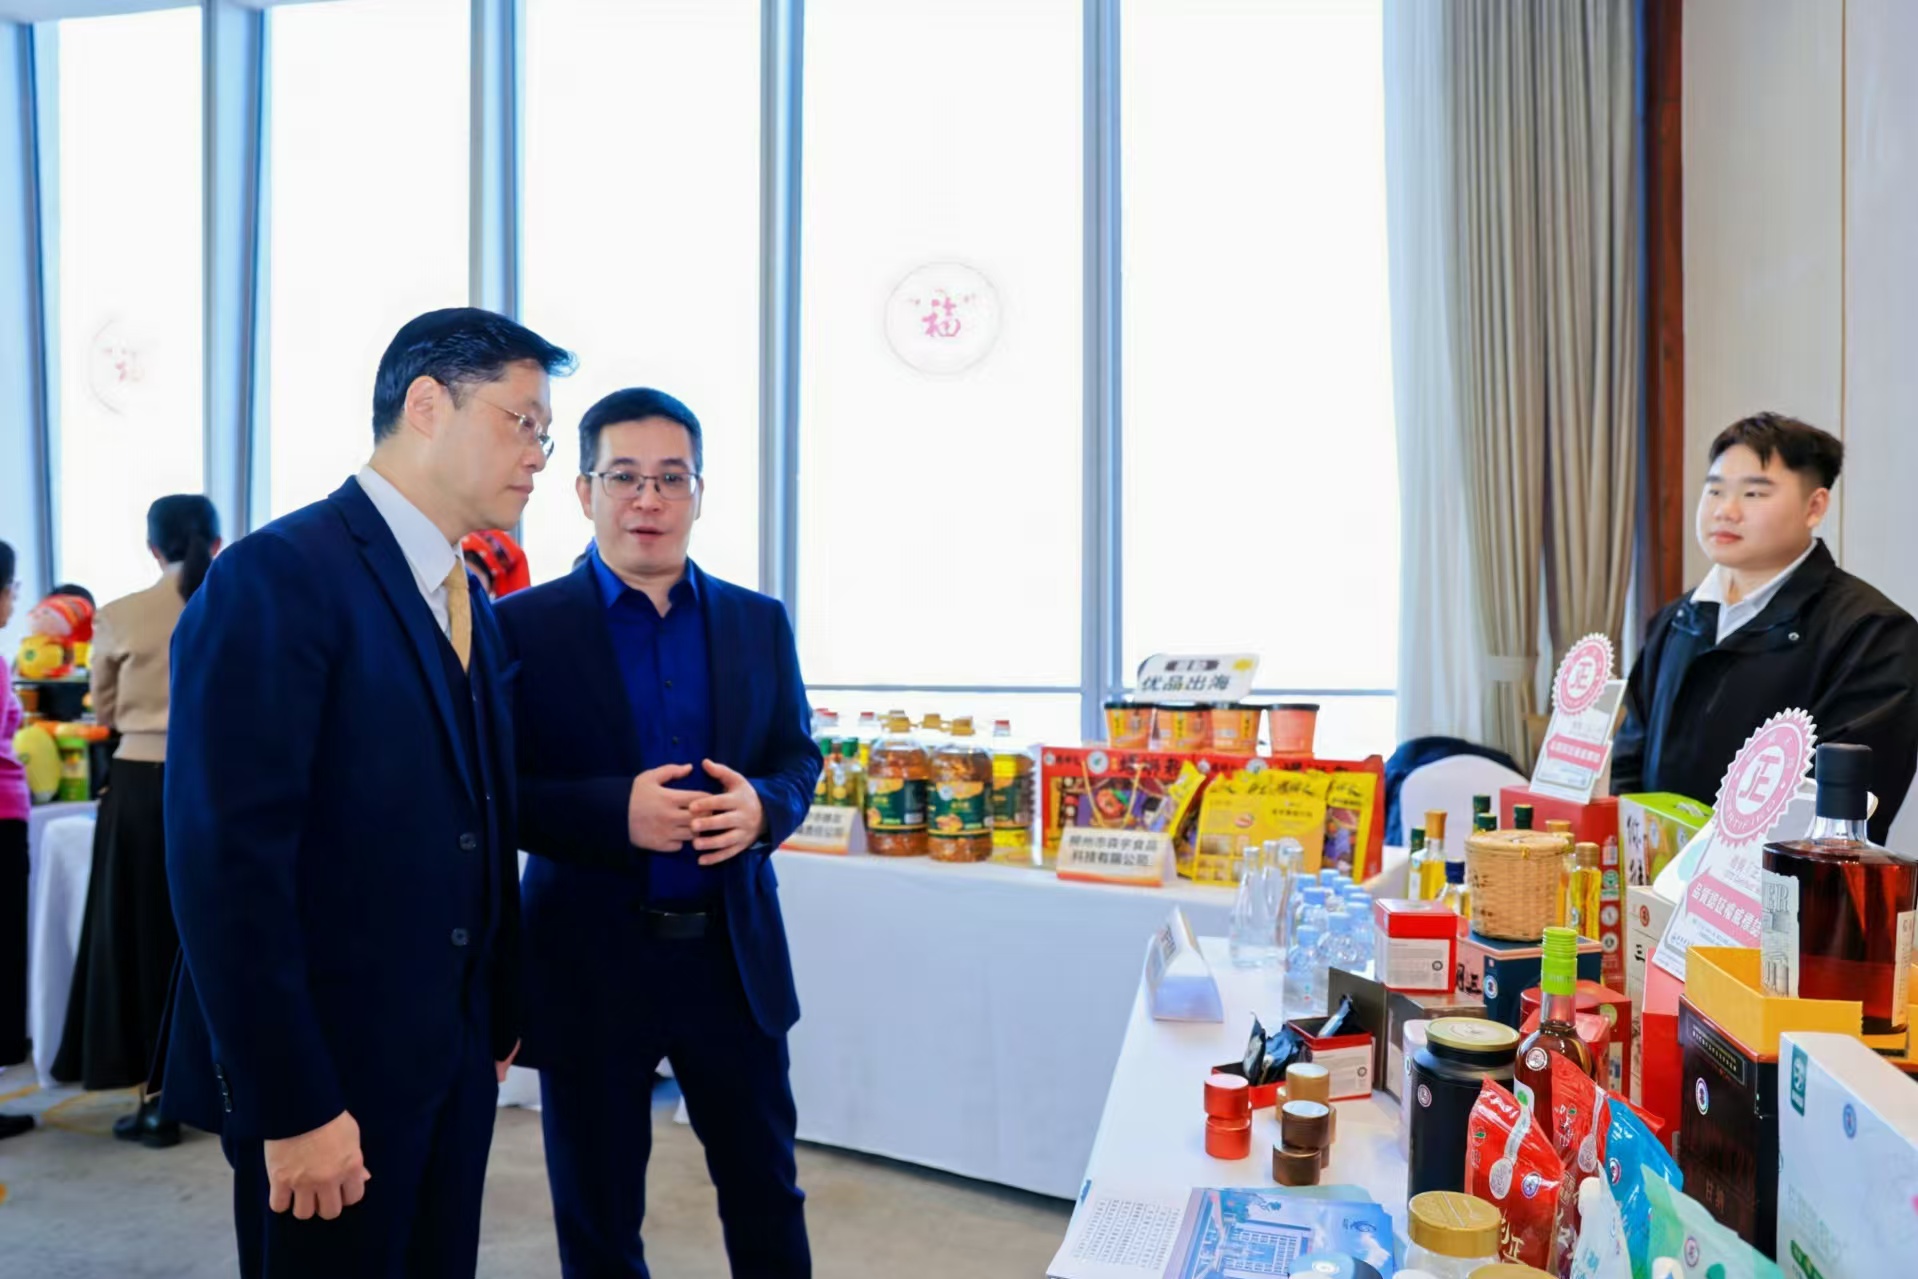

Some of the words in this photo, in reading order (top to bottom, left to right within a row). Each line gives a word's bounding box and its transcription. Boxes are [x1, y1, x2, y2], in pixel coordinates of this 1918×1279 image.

[1142, 675, 1231, 691] 优品出海
[1072, 850, 1153, 866] 科技有限公司
